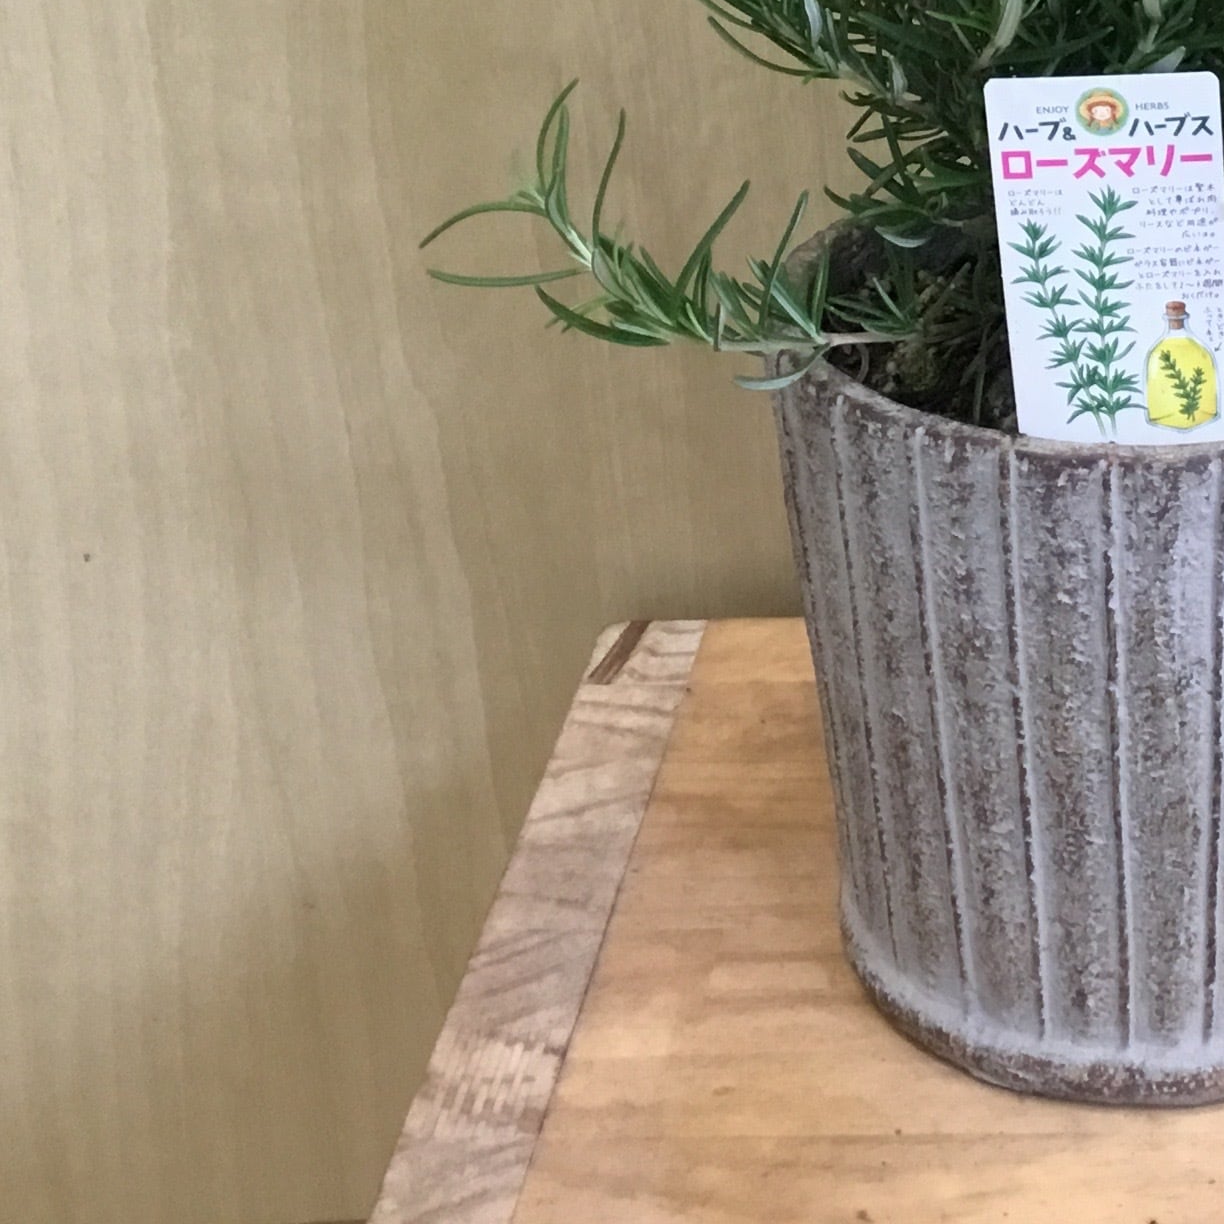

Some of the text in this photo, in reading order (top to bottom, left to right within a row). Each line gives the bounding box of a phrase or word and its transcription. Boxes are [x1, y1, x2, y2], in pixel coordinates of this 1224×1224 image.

[1036, 102, 1169, 115] ENJOY HERBS
[1128, 112, 1213, 137] ハーブス
[1001, 144, 1213, 179] ローズマリー
